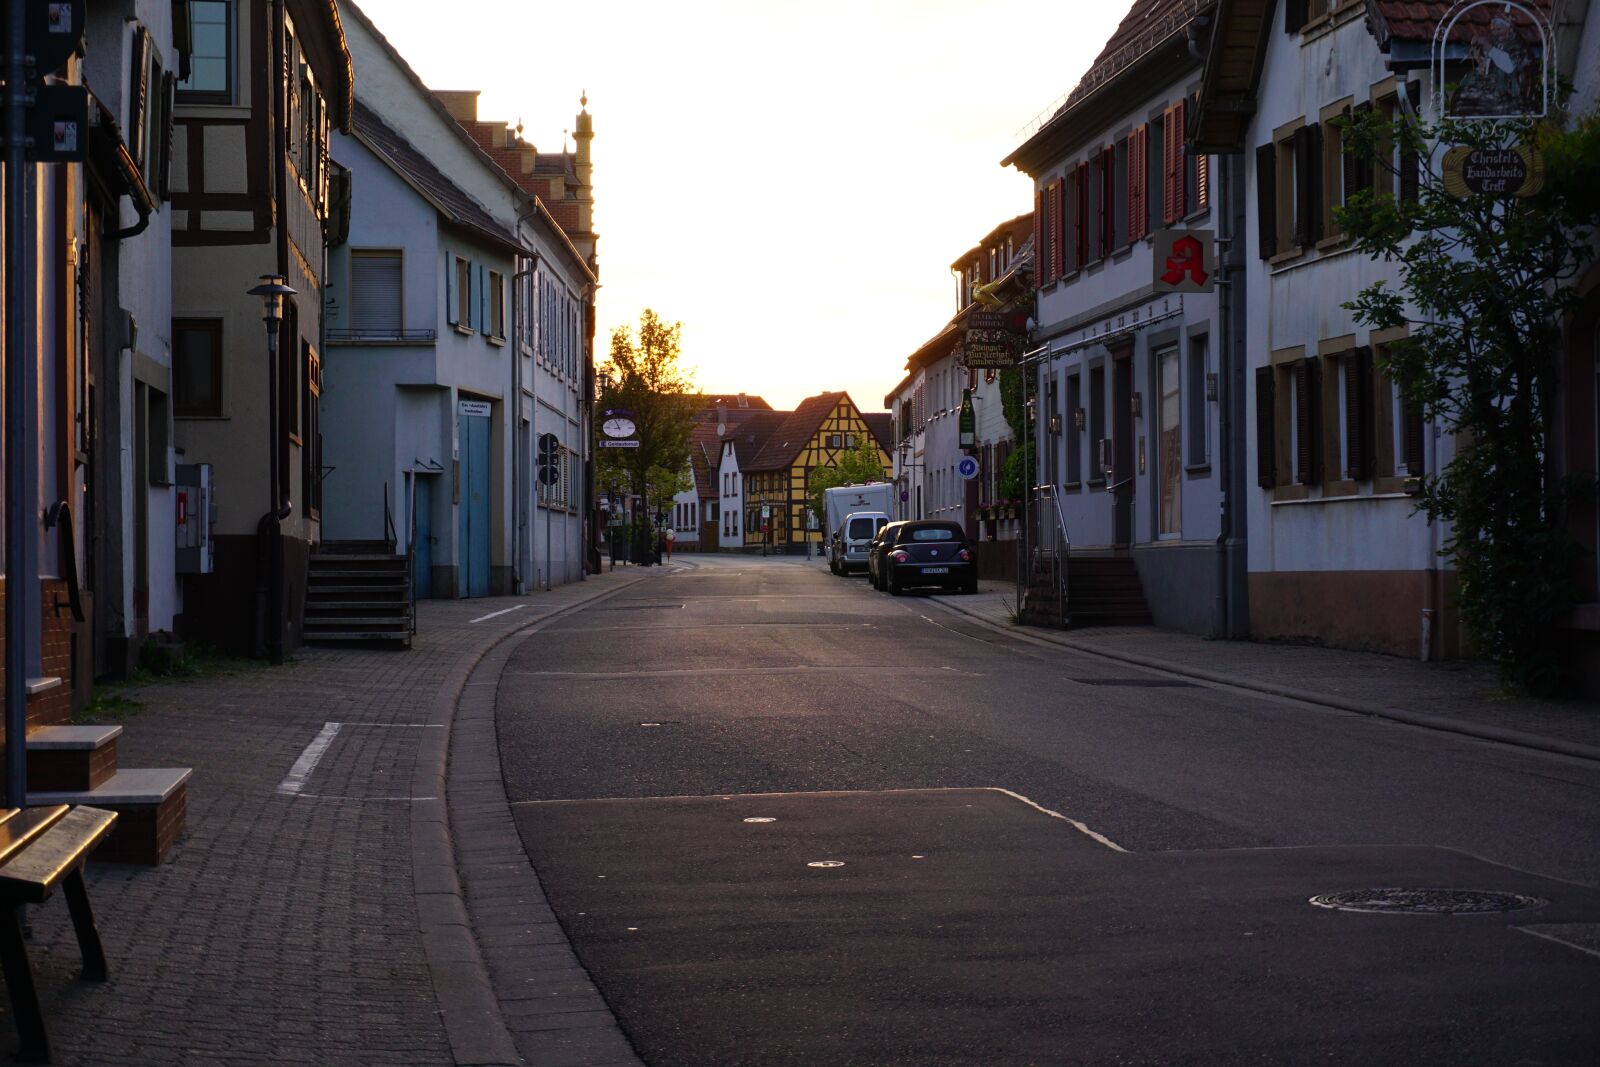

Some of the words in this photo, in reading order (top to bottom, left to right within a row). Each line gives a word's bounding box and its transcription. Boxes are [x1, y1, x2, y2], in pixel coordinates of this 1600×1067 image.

[1470, 151, 1519, 164] Christel's
[1467, 165, 1523, 178] Handarbeits
[1481, 179, 1506, 192] Treff
